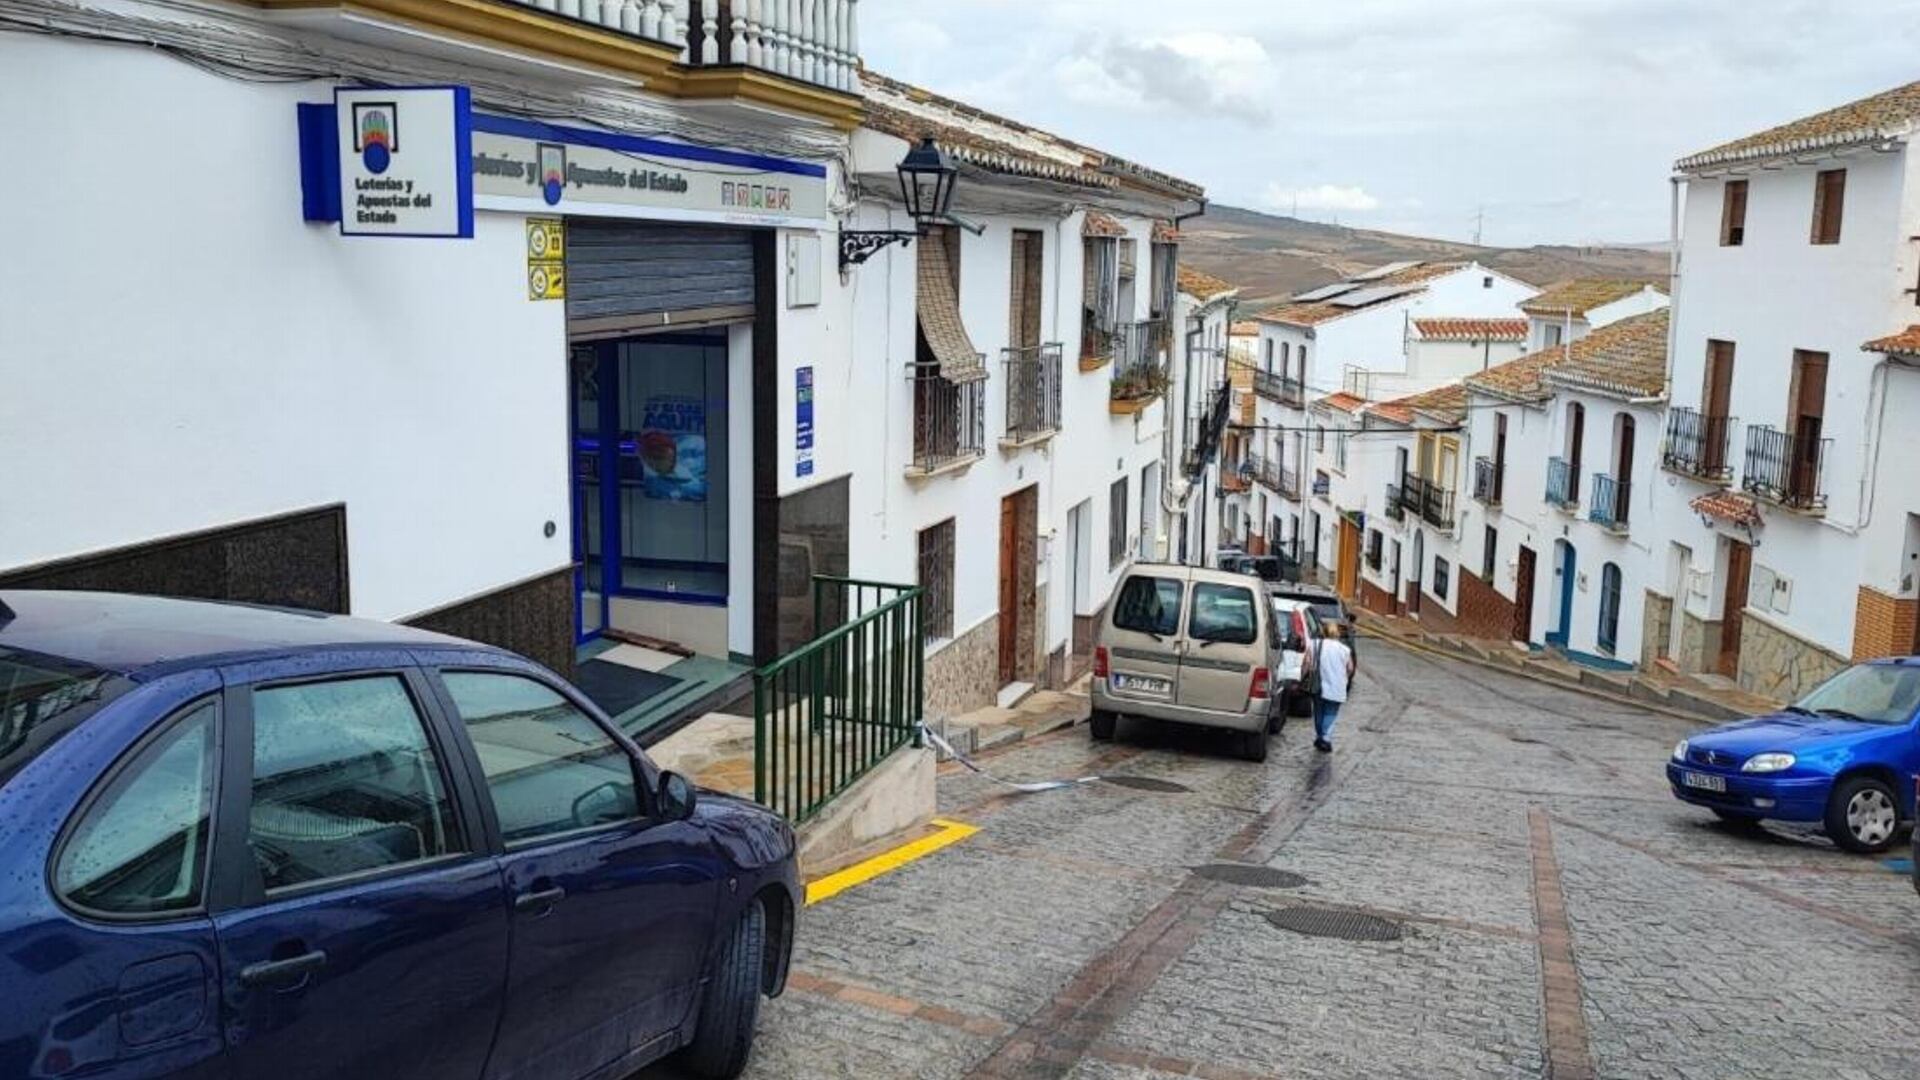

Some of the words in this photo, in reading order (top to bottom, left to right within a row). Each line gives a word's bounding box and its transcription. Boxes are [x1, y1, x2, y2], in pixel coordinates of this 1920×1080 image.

[472, 153, 524, 178] oterías
[526, 162, 537, 185] y
[567, 162, 627, 188] Apuestas
[628, 168, 648, 189] del
[649, 171, 688, 193] Estado
[355, 177, 403, 190] Loterías
[405, 180, 413, 194] y
[357, 194, 410, 209] Apuestas
[413, 193, 432, 207] del
[357, 210, 397, 224] Estado
